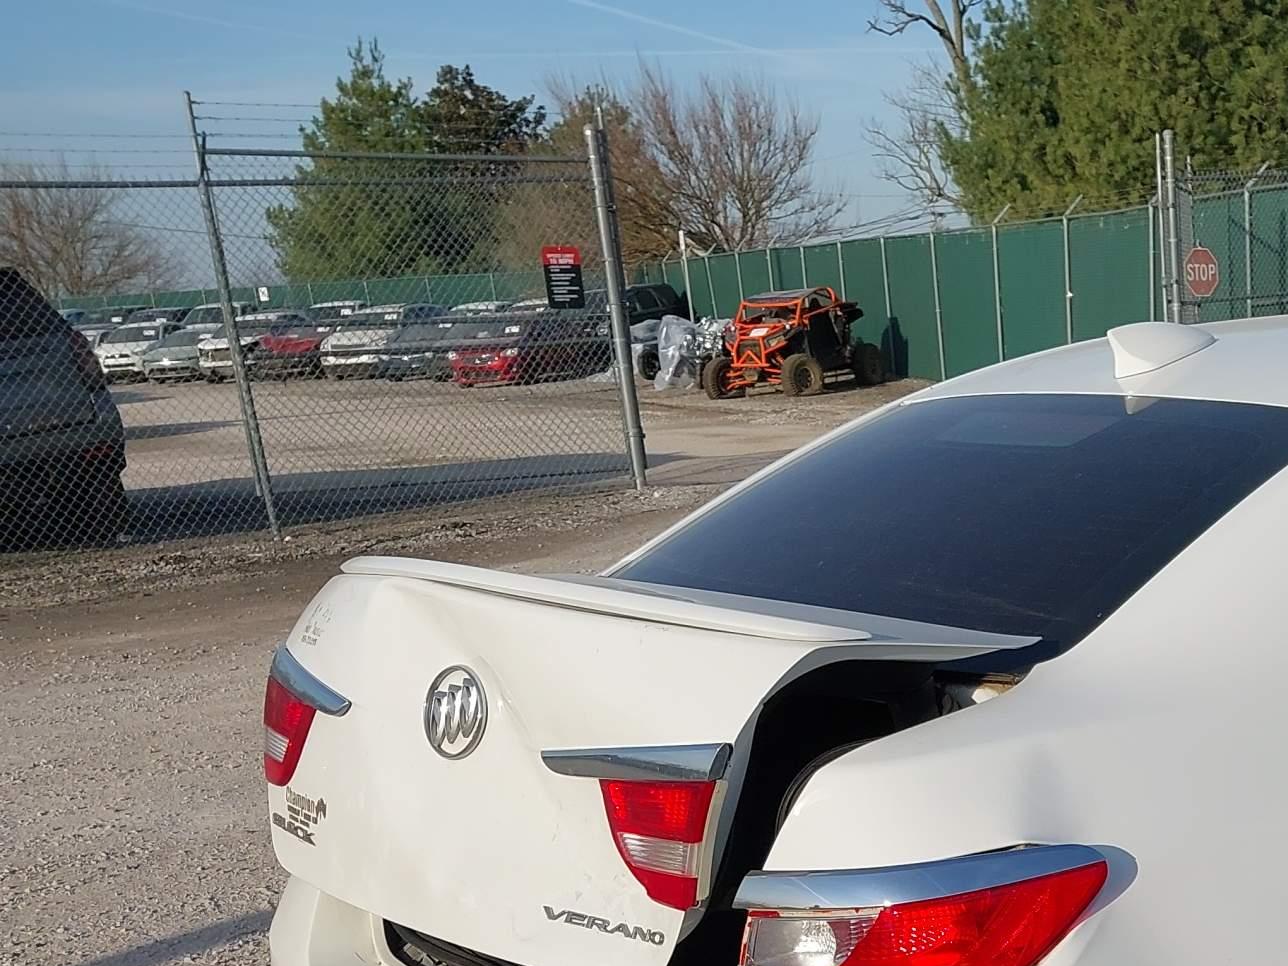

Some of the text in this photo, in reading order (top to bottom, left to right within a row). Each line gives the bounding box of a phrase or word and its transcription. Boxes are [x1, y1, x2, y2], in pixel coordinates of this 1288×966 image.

[1187, 263, 1215, 281] STOP
[272, 812, 316, 846] BUICK
[543, 905, 665, 946] VERANO
